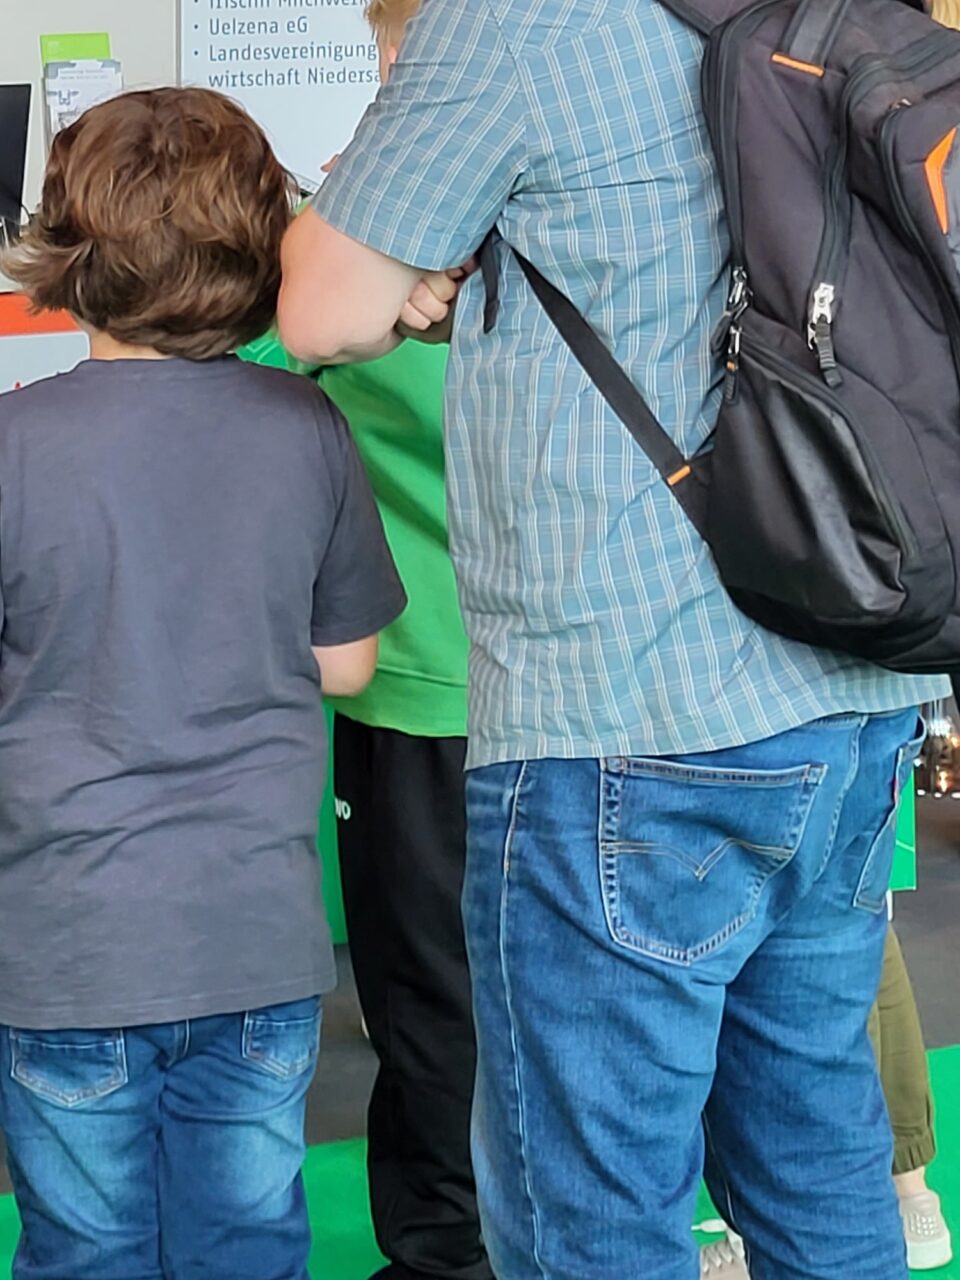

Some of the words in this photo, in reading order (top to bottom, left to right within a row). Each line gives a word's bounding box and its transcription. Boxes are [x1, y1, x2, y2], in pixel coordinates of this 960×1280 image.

[209, 18, 279, 36] Uelzena
[286, 15, 308, 33] eG
[208, 41, 377, 62] Landesvereinigung
[209, 68, 300, 87] wirtschaft
